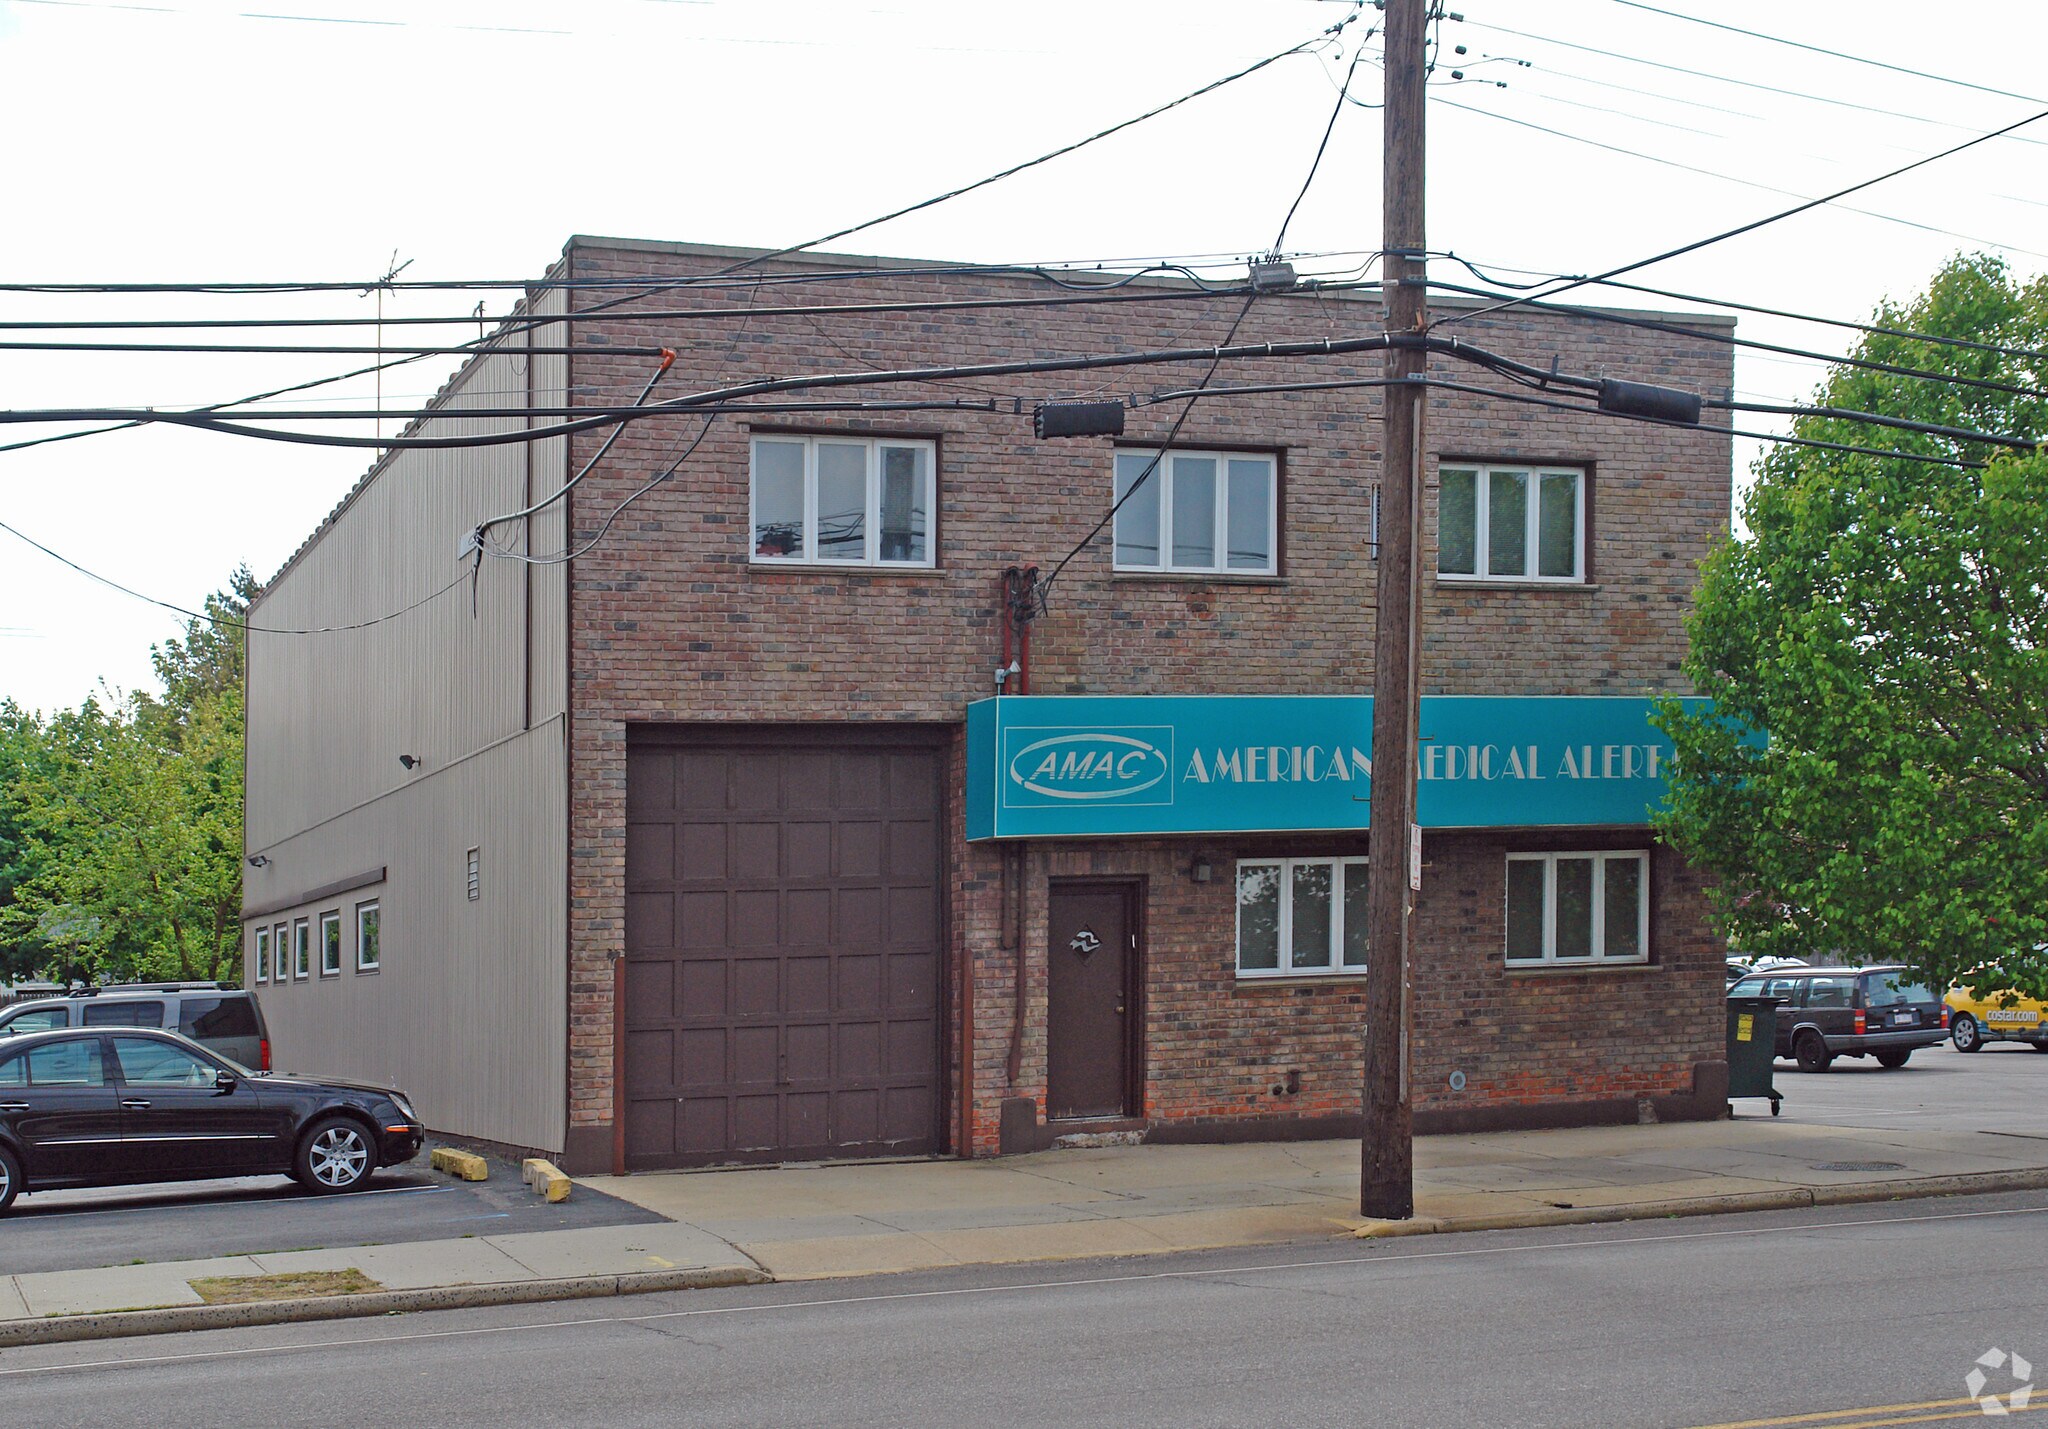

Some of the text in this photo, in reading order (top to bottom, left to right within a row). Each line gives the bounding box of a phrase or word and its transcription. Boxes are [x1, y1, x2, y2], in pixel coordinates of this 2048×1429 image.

[1029, 751, 1147, 780] AMAC
[1183, 746, 1372, 783] AMERICAN
[1417, 744, 1546, 780] EDICAL
[1556, 745, 1663, 779] ALERT
[1986, 1009, 2038, 1022] costar.com
